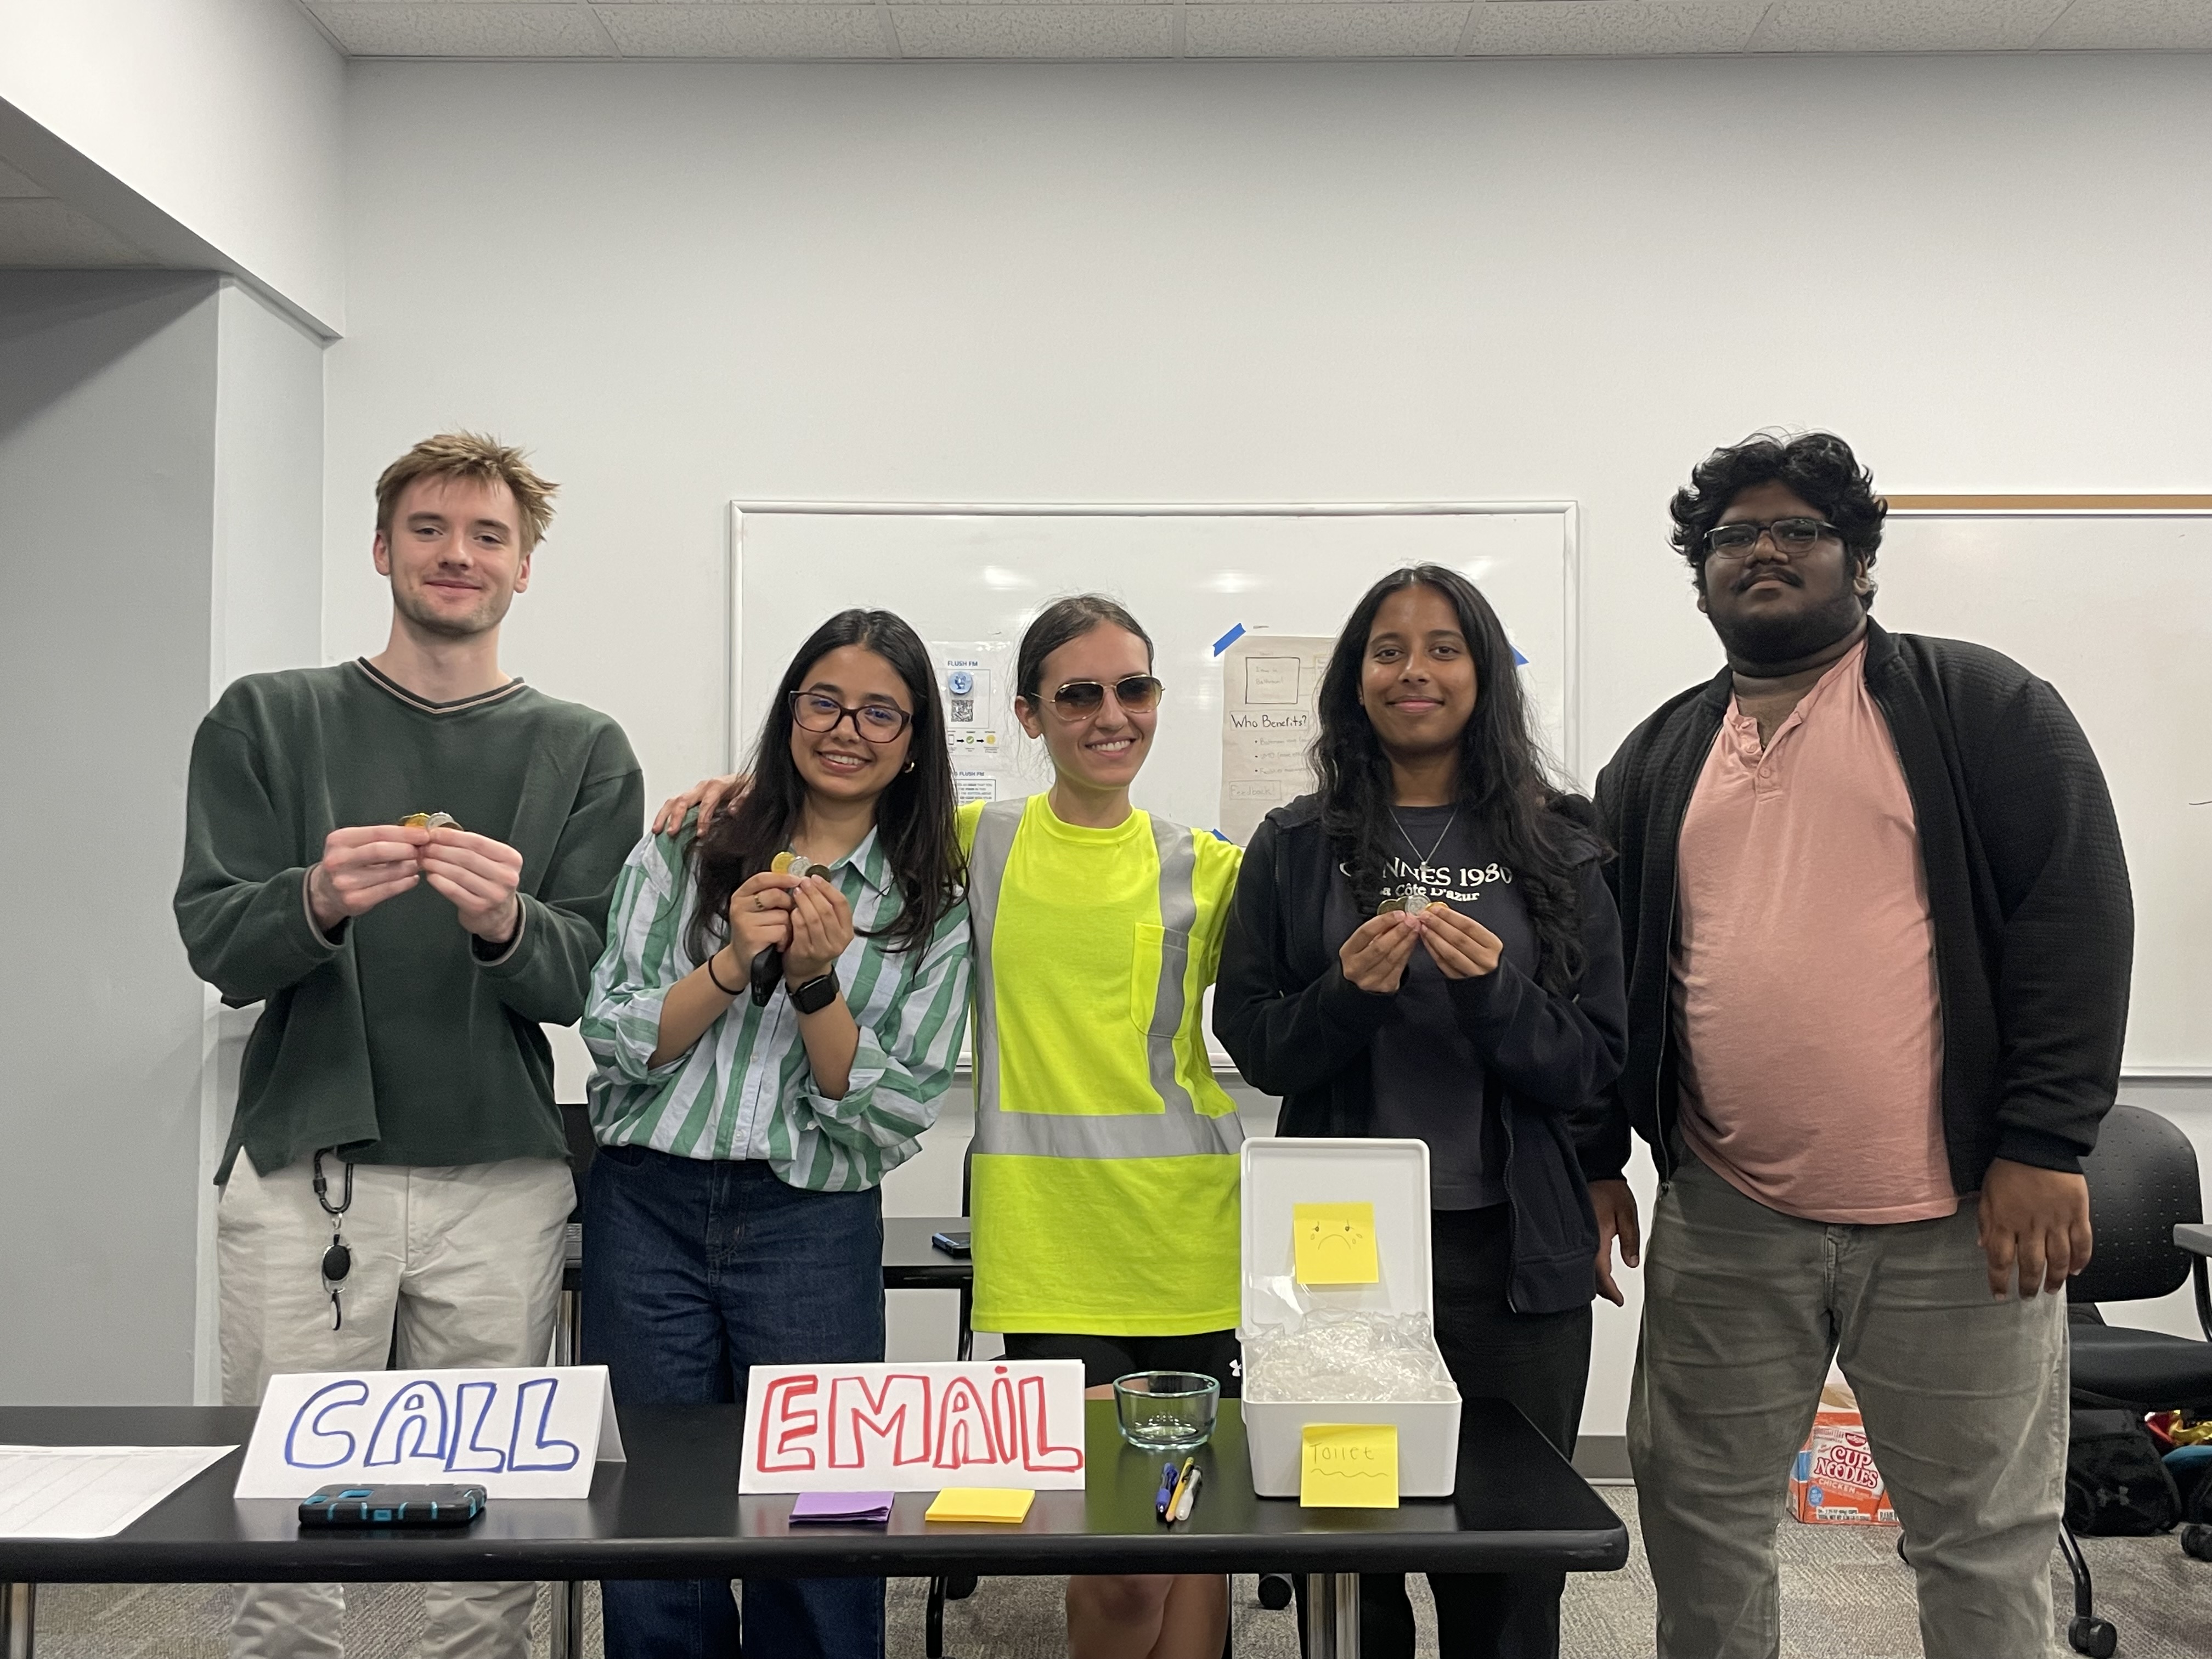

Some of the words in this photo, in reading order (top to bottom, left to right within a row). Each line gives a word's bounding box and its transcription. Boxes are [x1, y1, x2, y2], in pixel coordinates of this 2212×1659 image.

[1231, 714, 1258, 728] Who
[1262, 714, 1307, 728] Benefits?
[1459, 862, 1513, 887] 1980
[1395, 883, 1426, 896] Côte
[1430, 887, 1480, 902] D'azur
[284, 1378, 580, 1473] CALL
[1309, 1442, 1374, 1464] Toilet
[1831, 1445, 1872, 1469] CUP
[1814, 1457, 1879, 1488] NOODLES
[1819, 1478, 1856, 1494] CHICKEN
